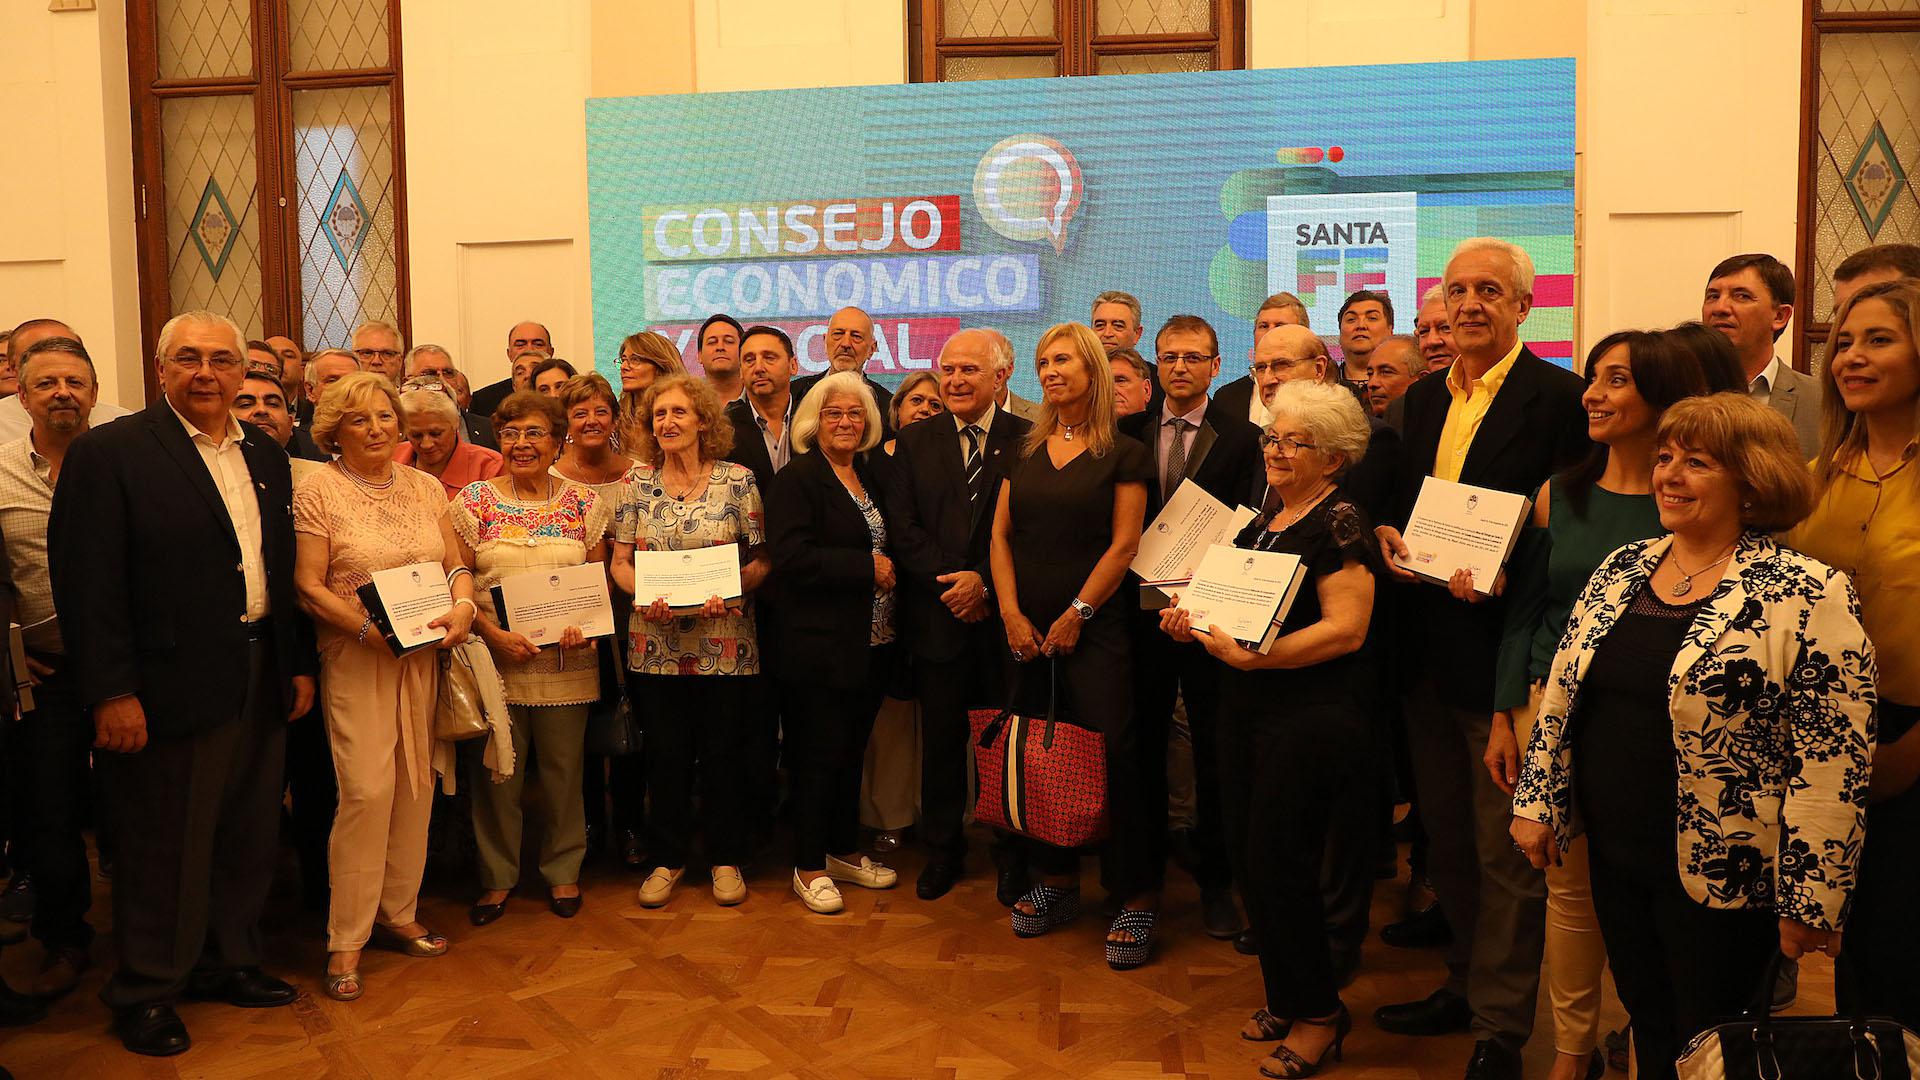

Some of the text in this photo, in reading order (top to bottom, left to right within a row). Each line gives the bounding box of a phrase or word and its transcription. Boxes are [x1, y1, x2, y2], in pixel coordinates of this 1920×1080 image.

[653, 200, 942, 257] CONSEJO
[1296, 222, 1388, 246] SANTA
[655, 256, 1029, 315] ECONOMICO
[1296, 248, 1388, 307] FE
